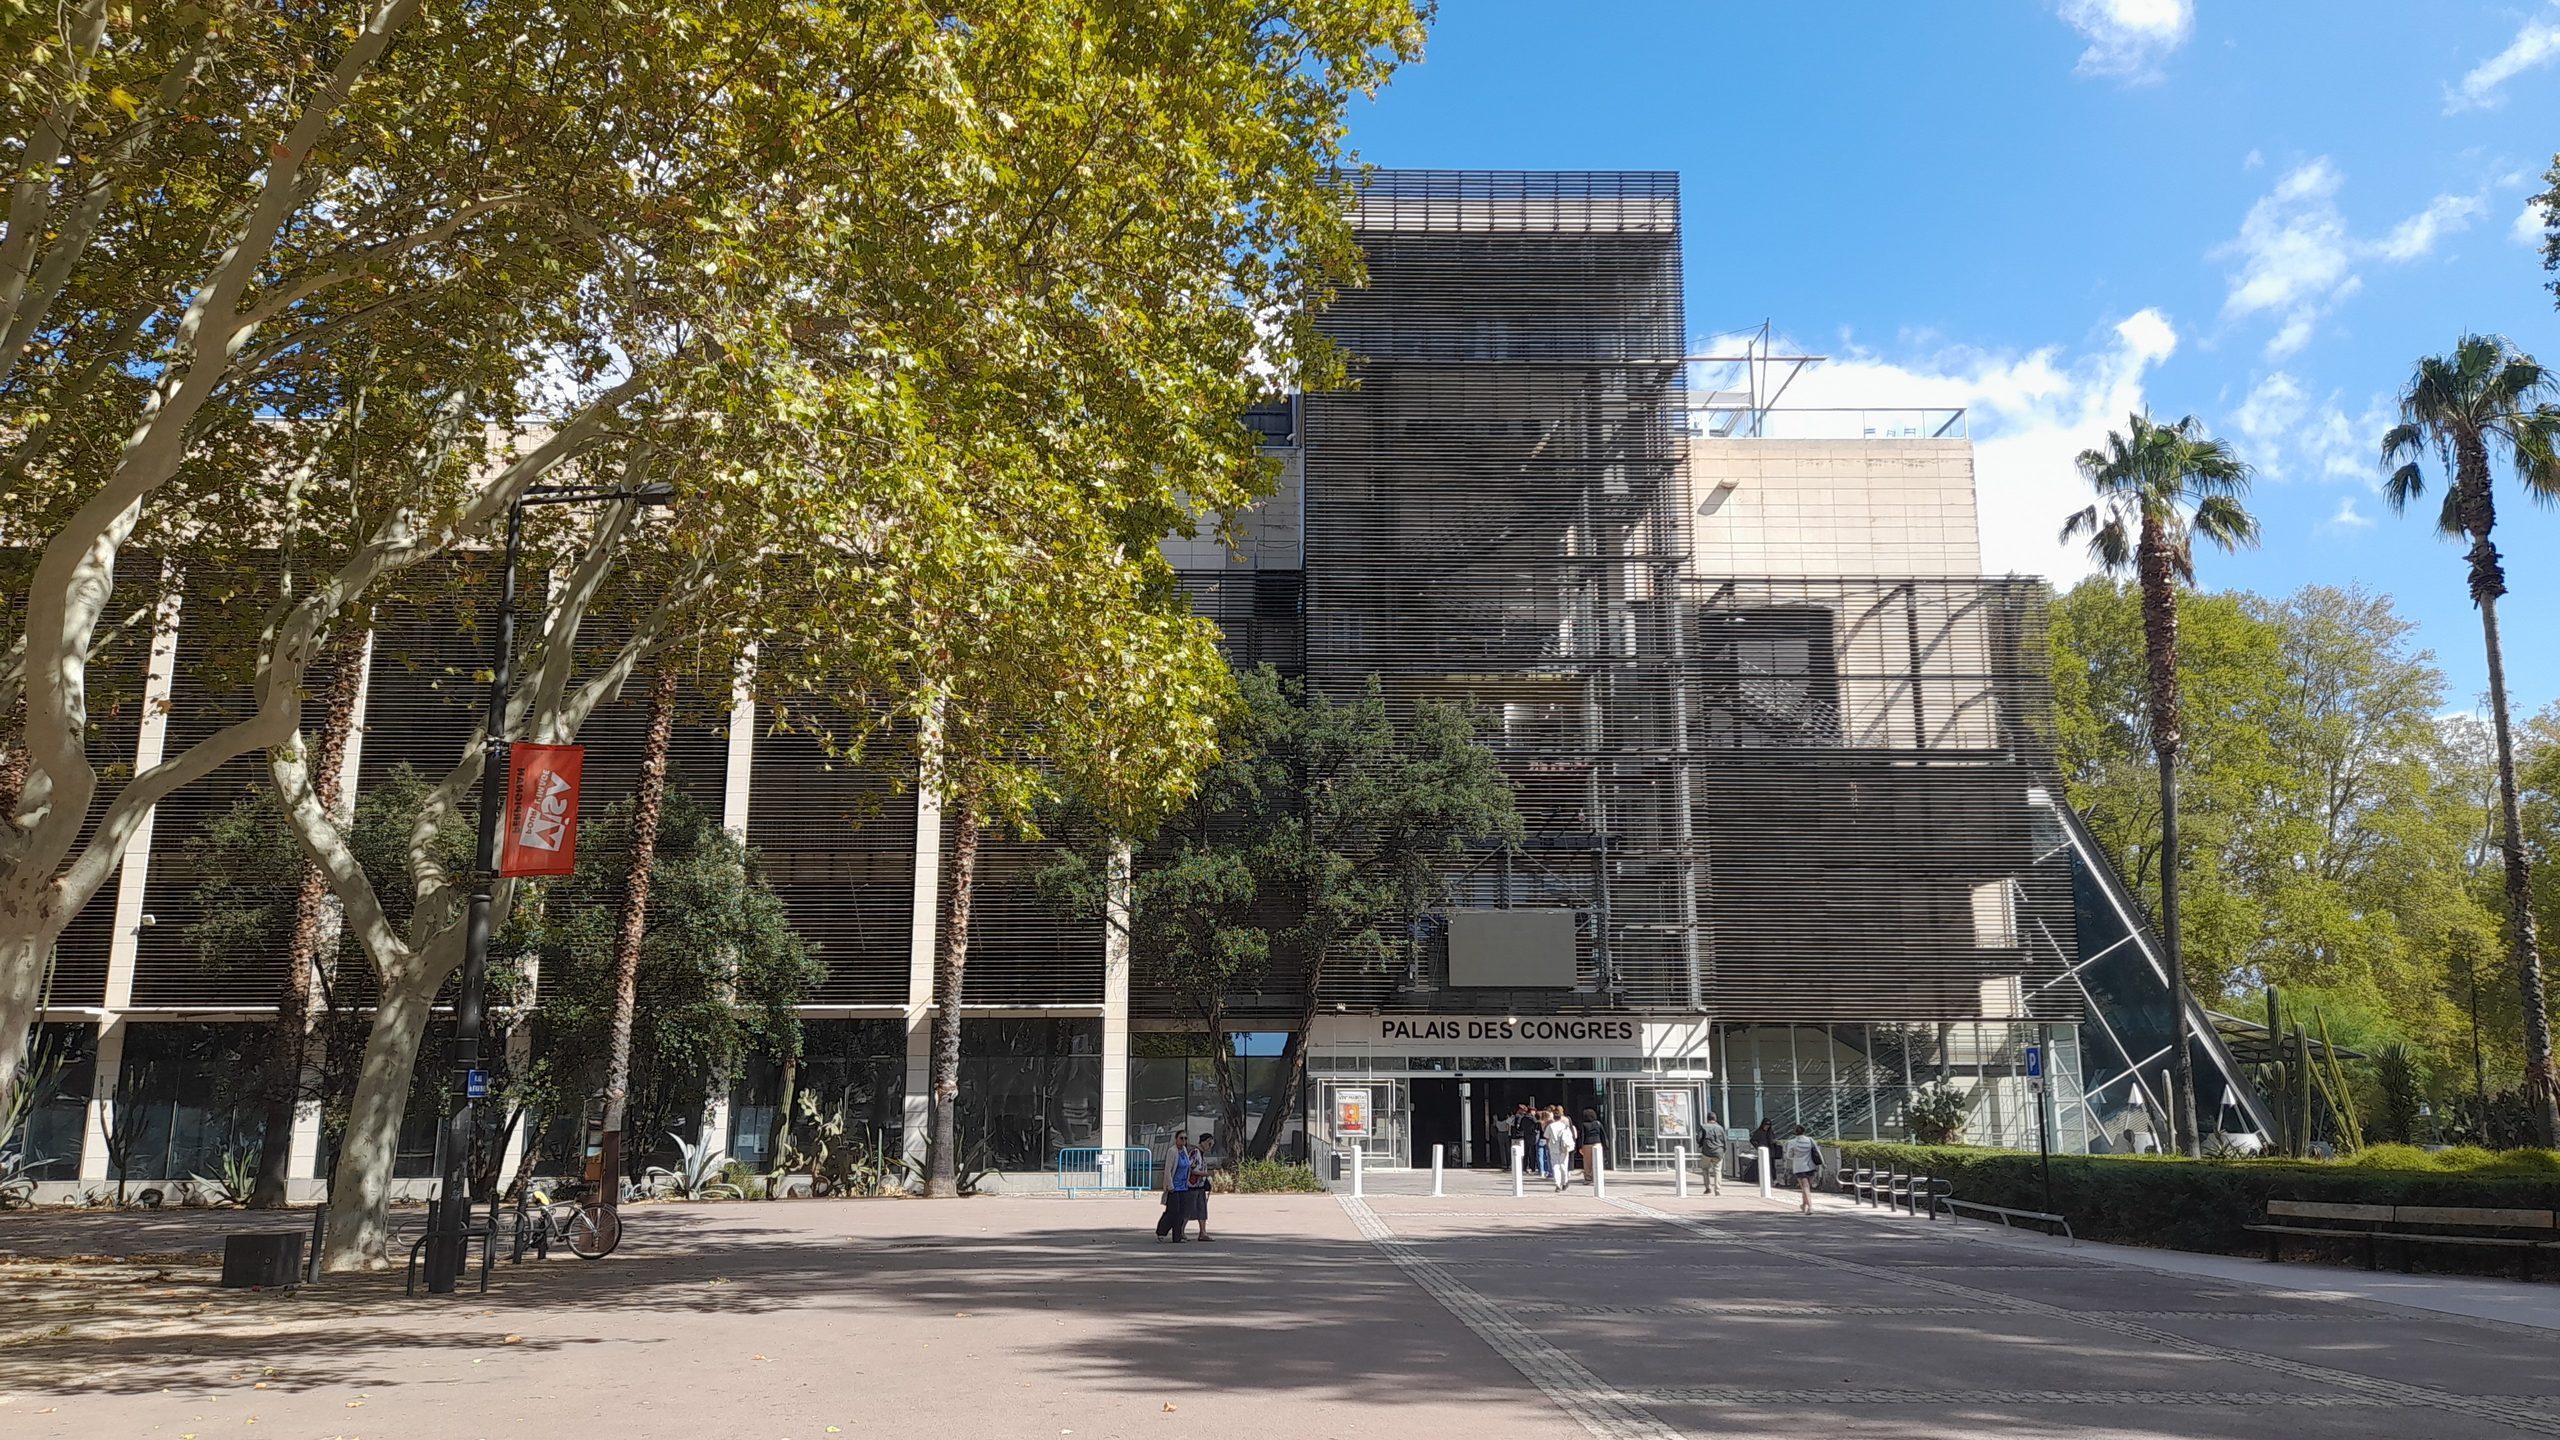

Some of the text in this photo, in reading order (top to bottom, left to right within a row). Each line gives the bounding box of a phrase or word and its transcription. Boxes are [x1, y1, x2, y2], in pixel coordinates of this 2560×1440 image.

[1382, 1021, 1632, 1040] PALAIS DES CONGRES
[2029, 1053, 2036, 1071] P
